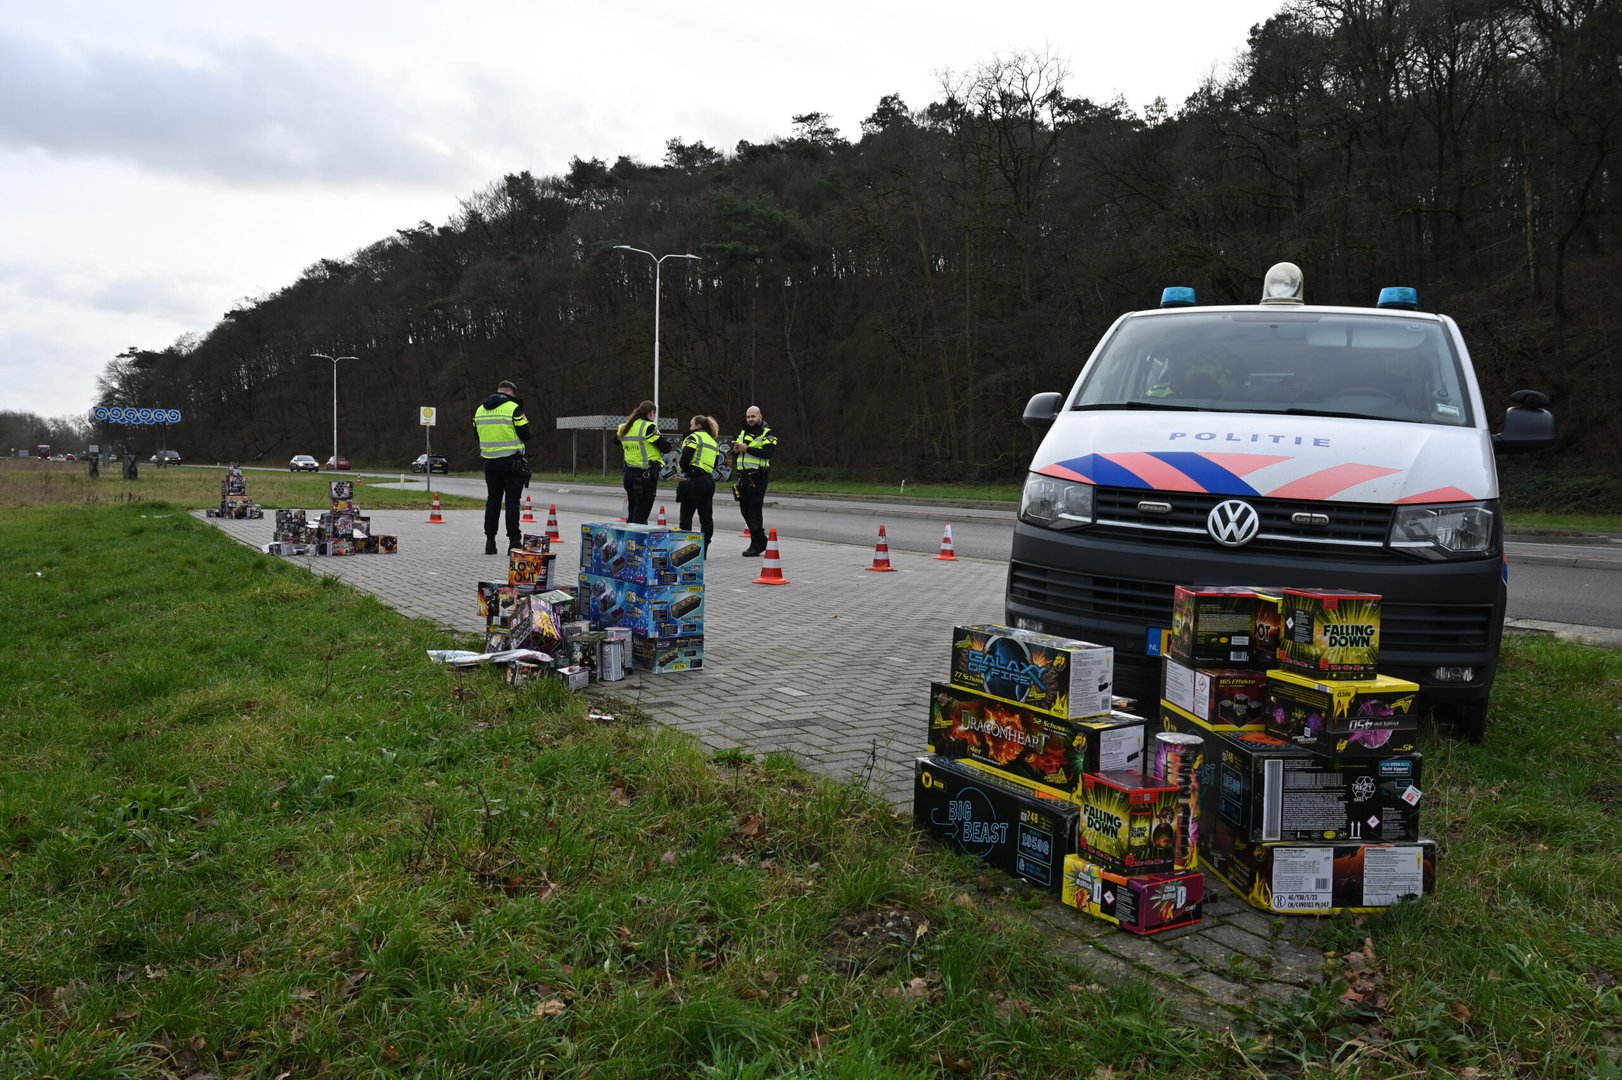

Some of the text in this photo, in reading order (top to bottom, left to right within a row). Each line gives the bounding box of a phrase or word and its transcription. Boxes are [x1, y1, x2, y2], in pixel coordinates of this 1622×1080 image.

[1168, 431, 1332, 448] POLITIE
[510, 560, 539, 572] BLOW
[514, 572, 537, 583] OUT
[1323, 624, 1375, 637] FALLING
[1148, 643, 1159, 651] NL
[1328, 636, 1371, 648] DOWN
[968, 650, 1048, 691] GALAXY
[968, 662, 988, 673] OF
[990, 668, 1032, 686] FIRE
[961, 709, 1050, 755] DRAGONHEART
[1348, 719, 1373, 730] 450
[1083, 804, 1122, 829] FALLING
[963, 822, 1009, 844] BEAST
[1087, 816, 1118, 840] DOWN
